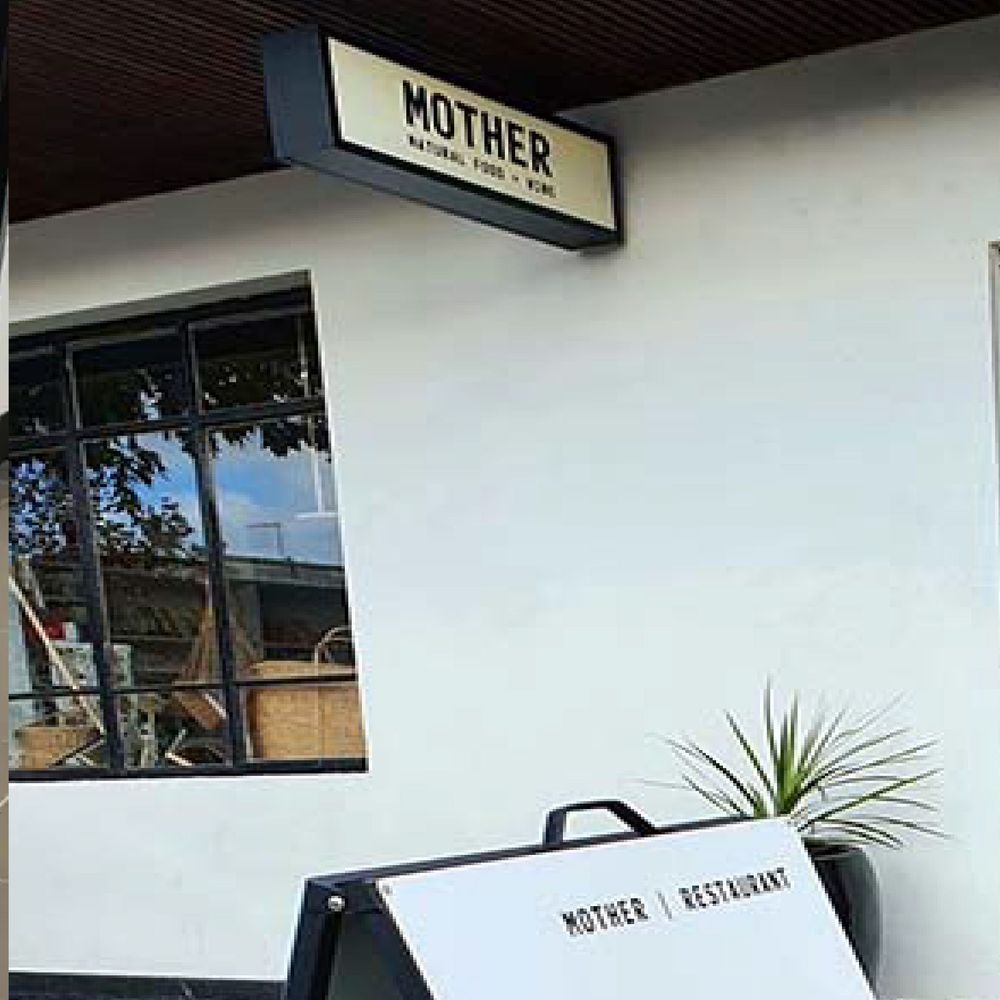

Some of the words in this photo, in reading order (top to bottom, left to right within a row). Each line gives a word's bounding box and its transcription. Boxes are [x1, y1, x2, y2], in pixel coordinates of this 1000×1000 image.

[402, 79, 553, 177] MOTHER
[562, 897, 649, 937] MOTHER
[678, 866, 792, 911] RESTAURANT
